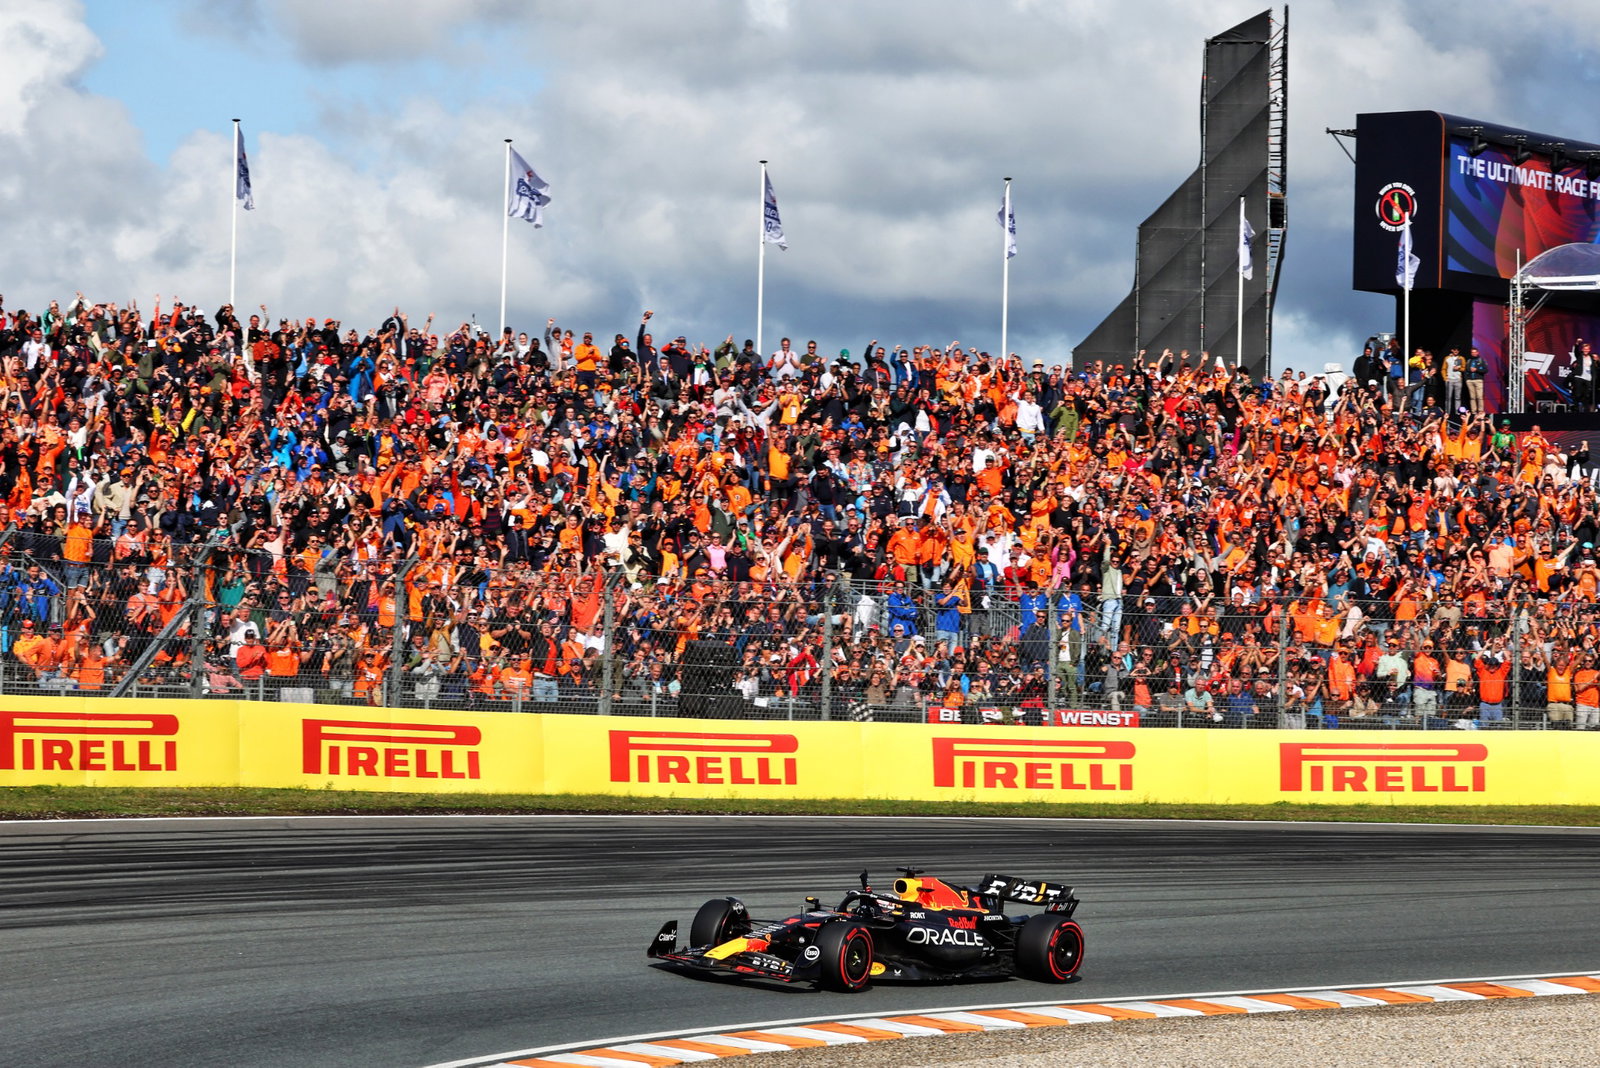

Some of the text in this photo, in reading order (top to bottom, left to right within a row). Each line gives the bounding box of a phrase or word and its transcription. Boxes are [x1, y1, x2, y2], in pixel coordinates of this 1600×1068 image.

[1457, 155, 1485, 178] THE
[1487, 161, 1552, 191] ULTIMATE
[1554, 174, 1587, 198] RACE
[0, 711, 179, 771] PIRELLI
[1060, 711, 1134, 726] WENST
[302, 718, 481, 780] PIRELLI
[608, 730, 799, 785] PIRELLI
[932, 737, 1136, 791] PIRELLI
[1279, 742, 1488, 792] PIRELLI
[906, 927, 984, 946] ORACLE
